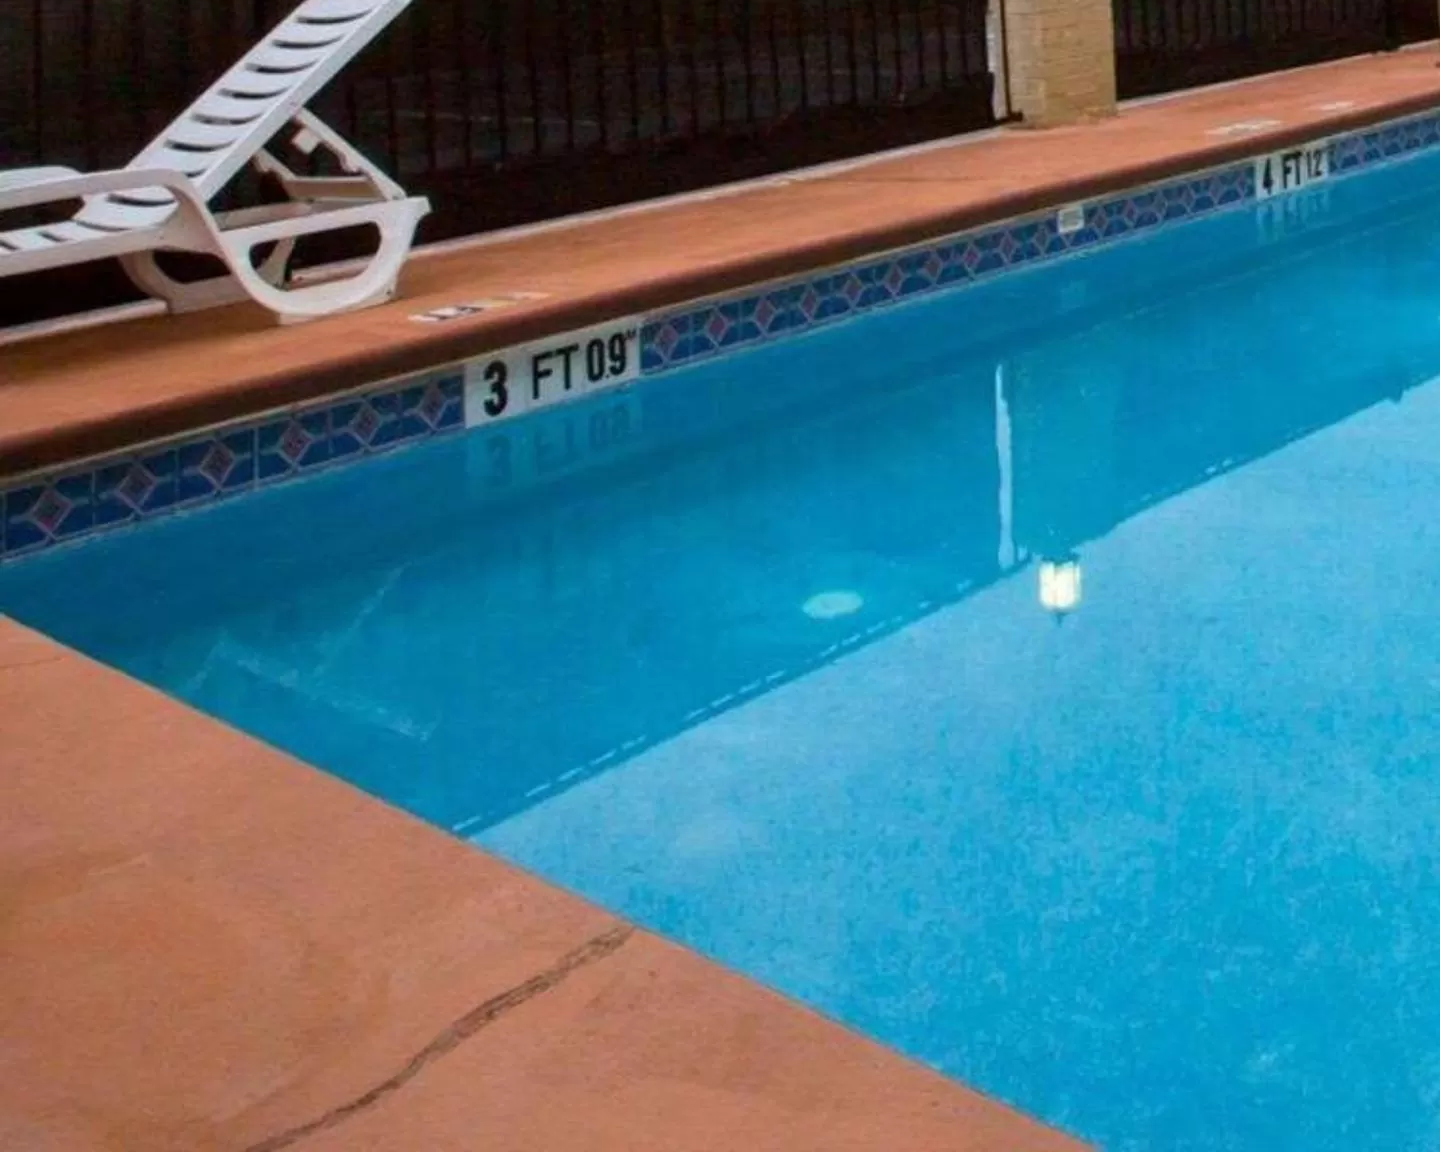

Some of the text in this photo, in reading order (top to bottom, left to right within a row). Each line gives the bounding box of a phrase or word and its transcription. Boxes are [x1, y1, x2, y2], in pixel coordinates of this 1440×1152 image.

[1262, 156, 1273, 195] 4
[1282, 150, 1304, 189] FT
[483, 359, 508, 416] 3
[532, 342, 580, 399] FT
